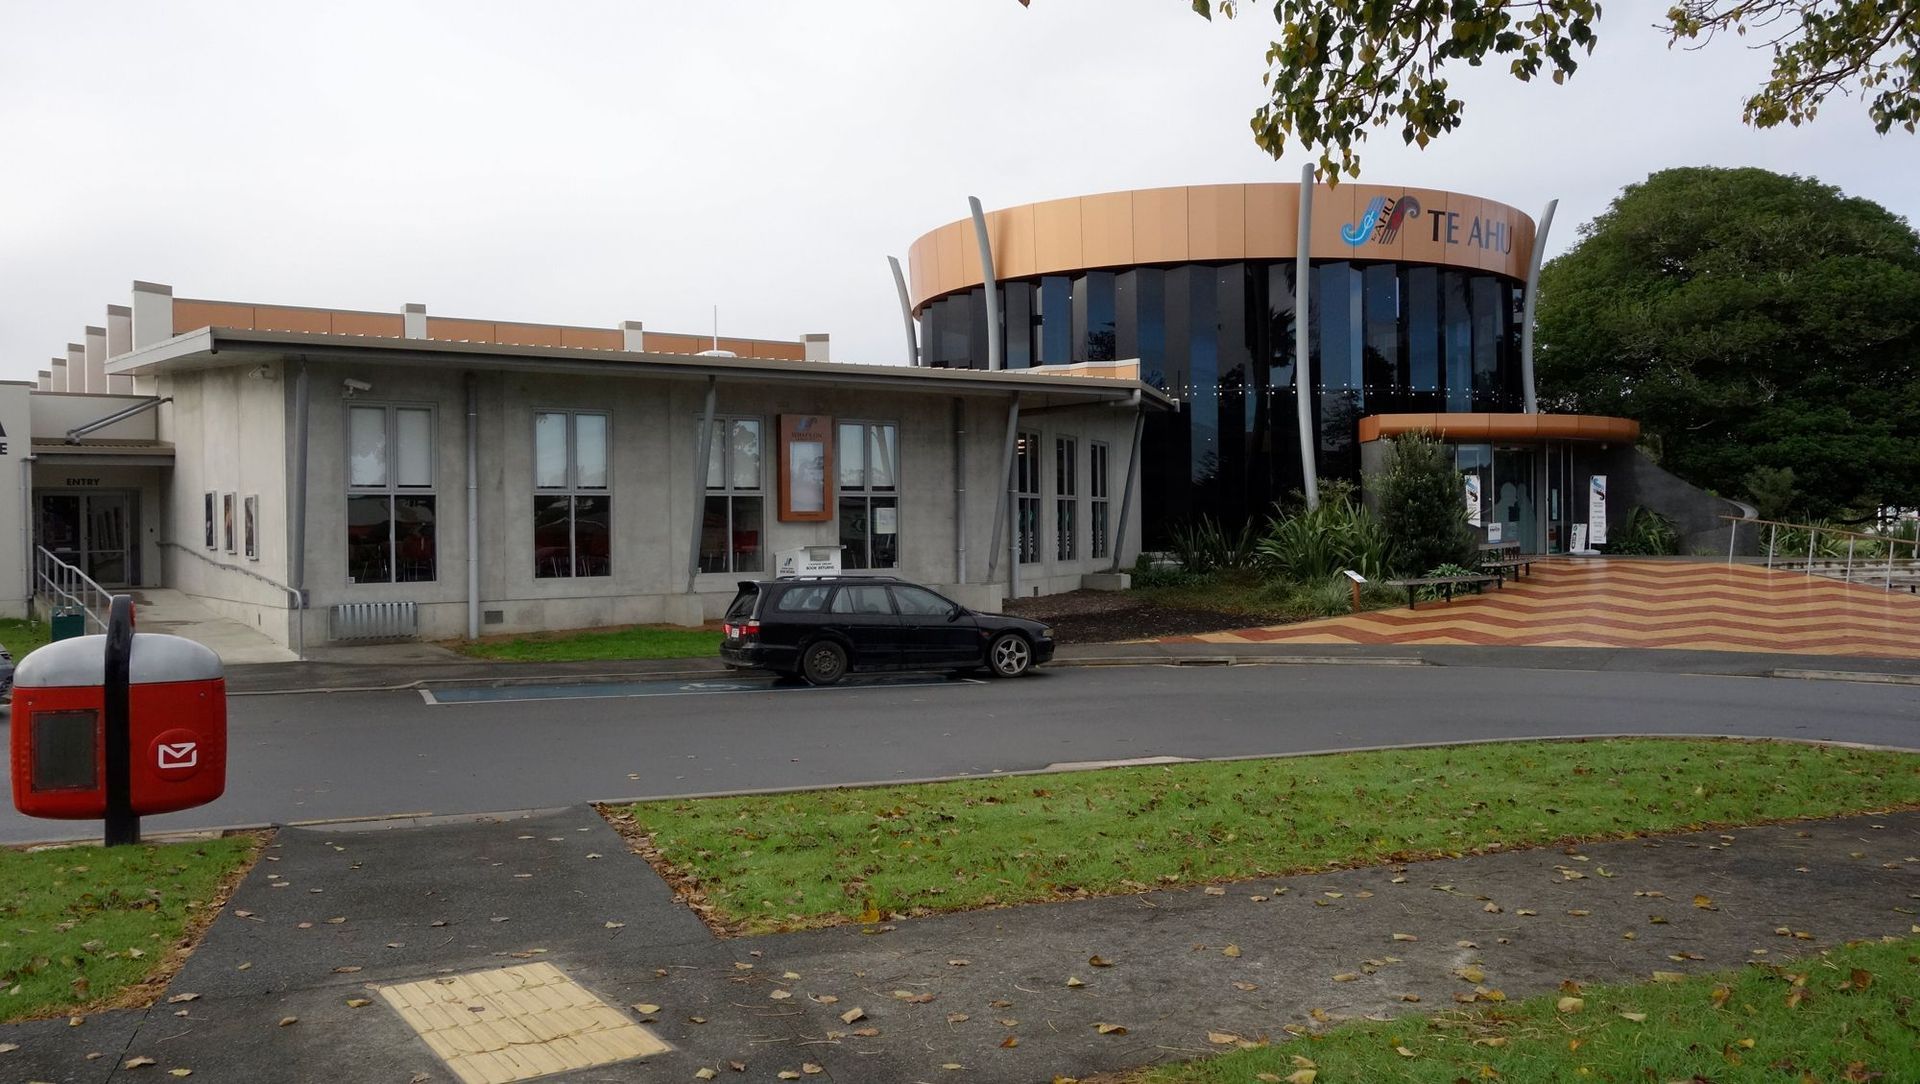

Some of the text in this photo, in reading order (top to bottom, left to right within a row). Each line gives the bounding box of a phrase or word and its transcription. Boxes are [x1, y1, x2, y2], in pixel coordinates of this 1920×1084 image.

[1375, 198, 1396, 236] AHU
[1427, 210, 1512, 255] TE AHU
[66, 478, 100, 486] ENTRY
